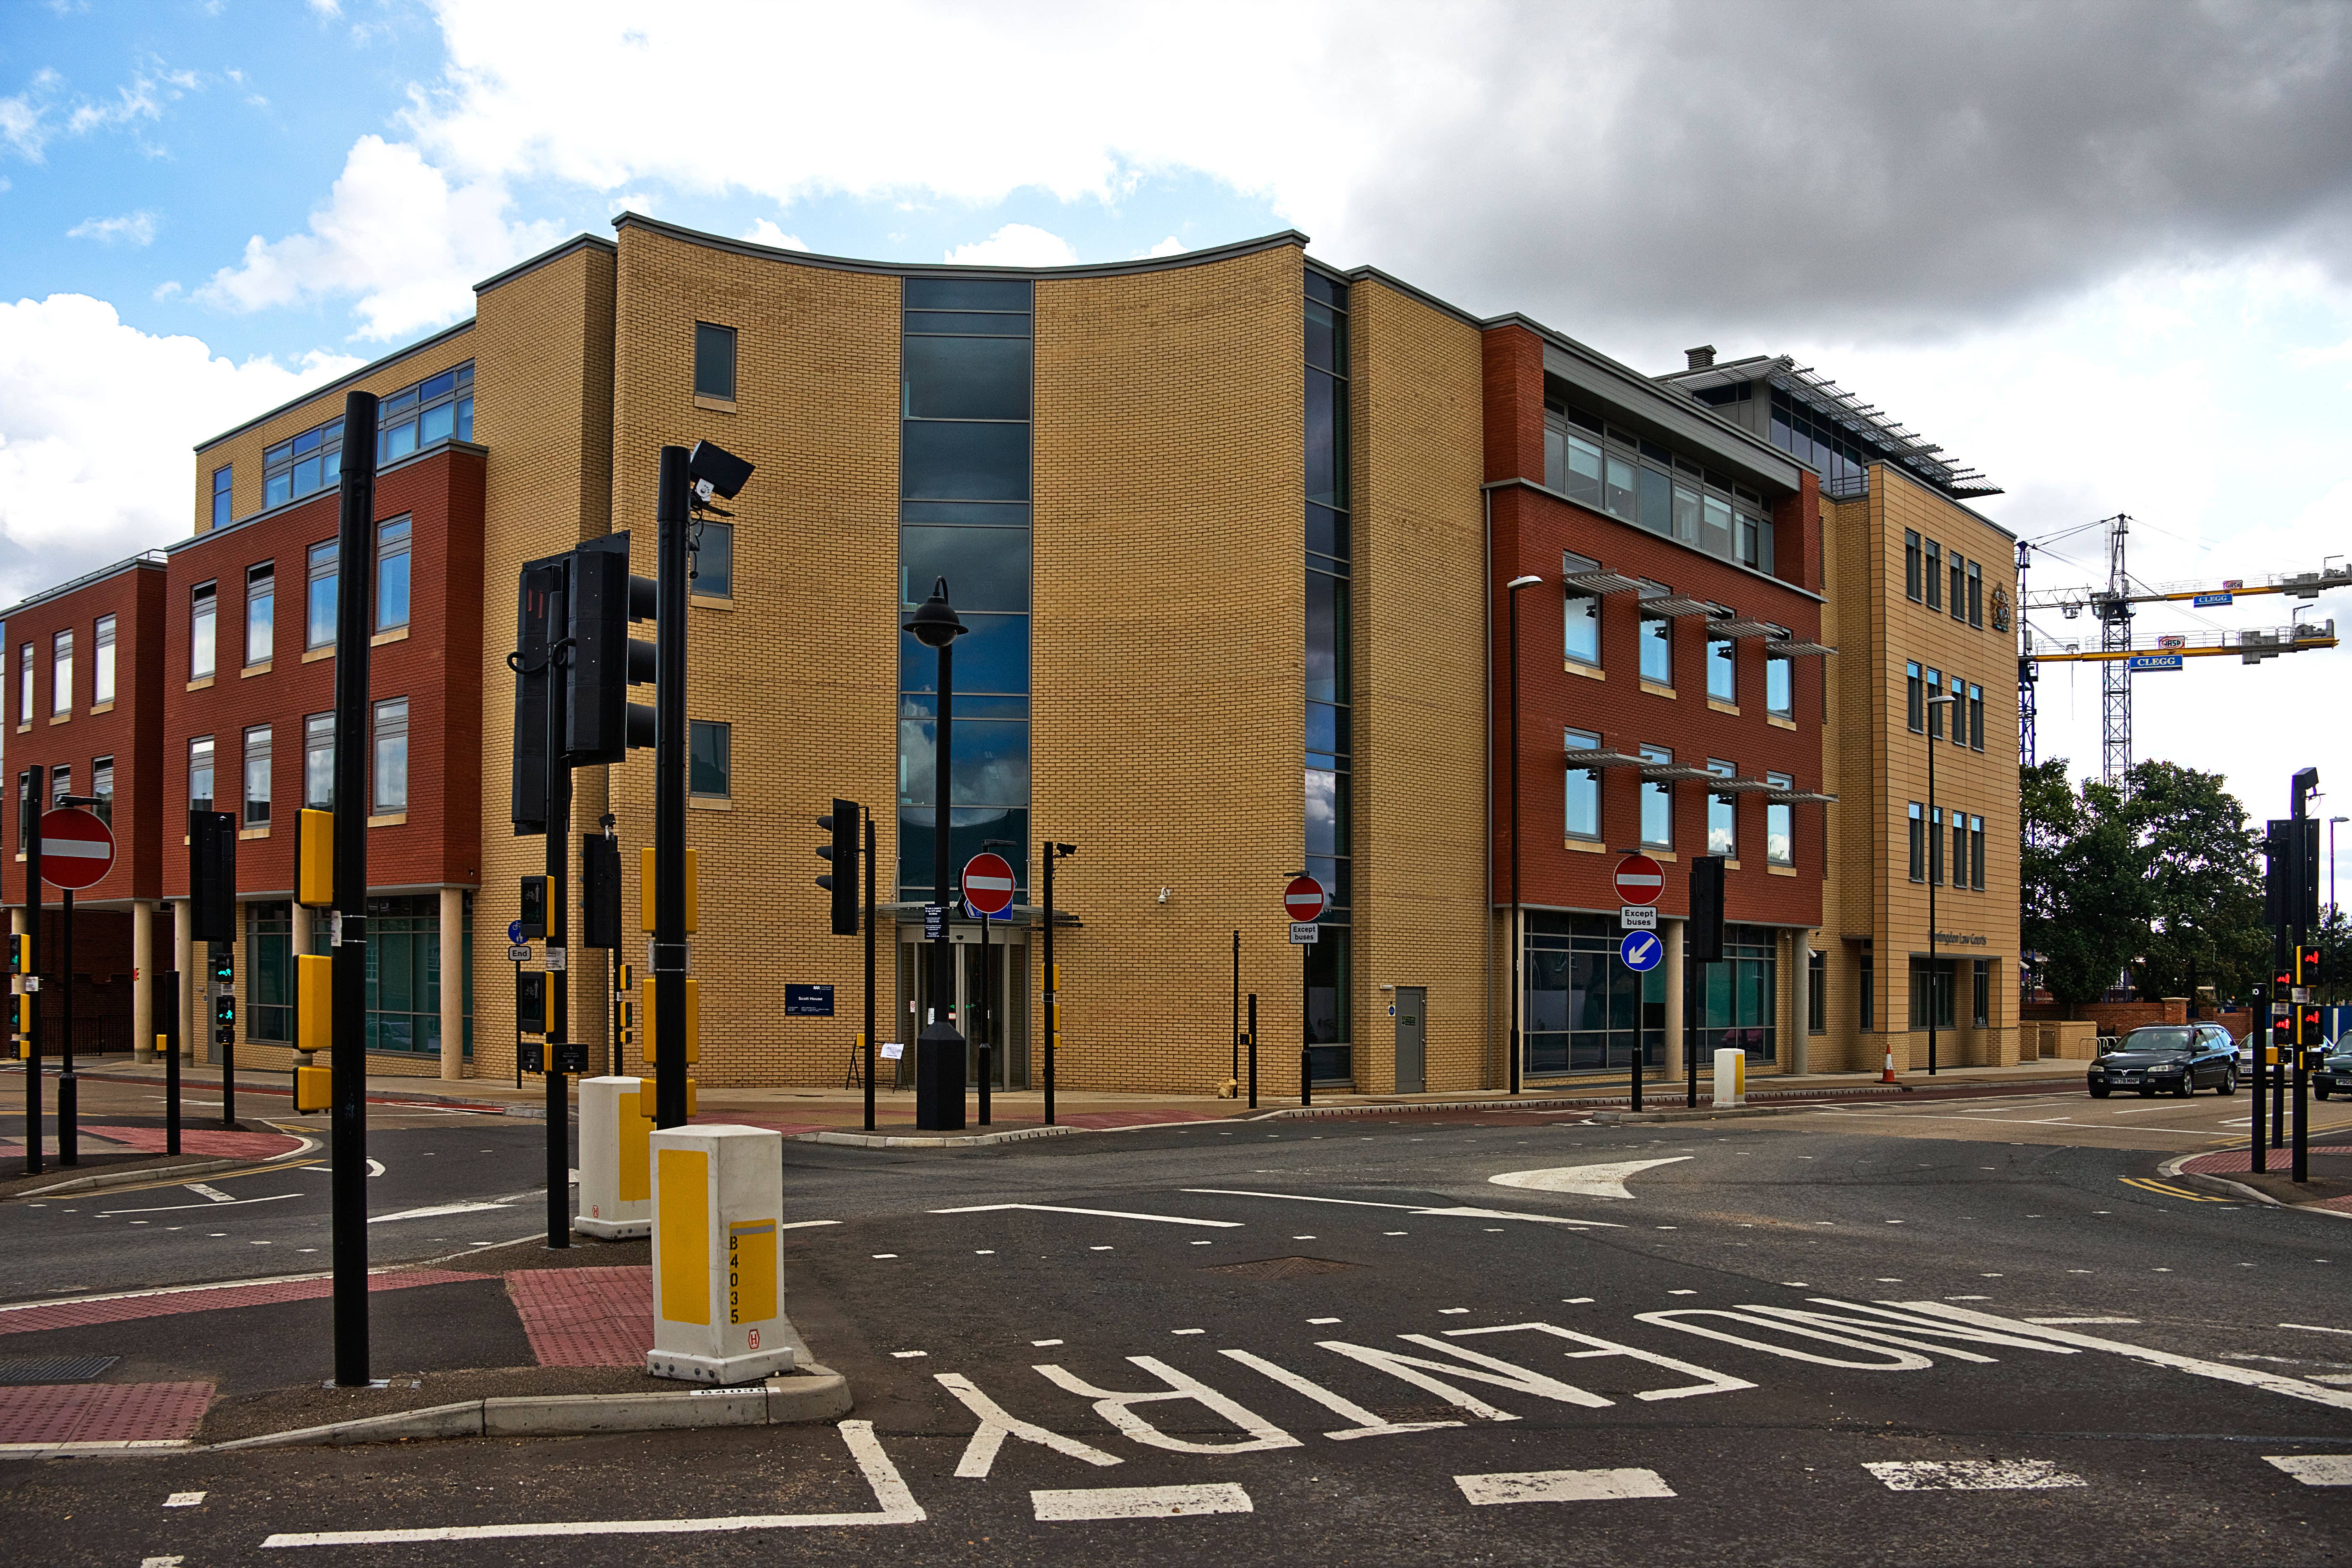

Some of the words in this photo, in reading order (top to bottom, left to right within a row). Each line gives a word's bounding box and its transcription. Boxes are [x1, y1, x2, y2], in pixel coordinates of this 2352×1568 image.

[2137, 657, 2175, 666] CLEGG
[730, 1235, 739, 1324] B4035
[934, 1322, 1758, 1478] ENTRY
